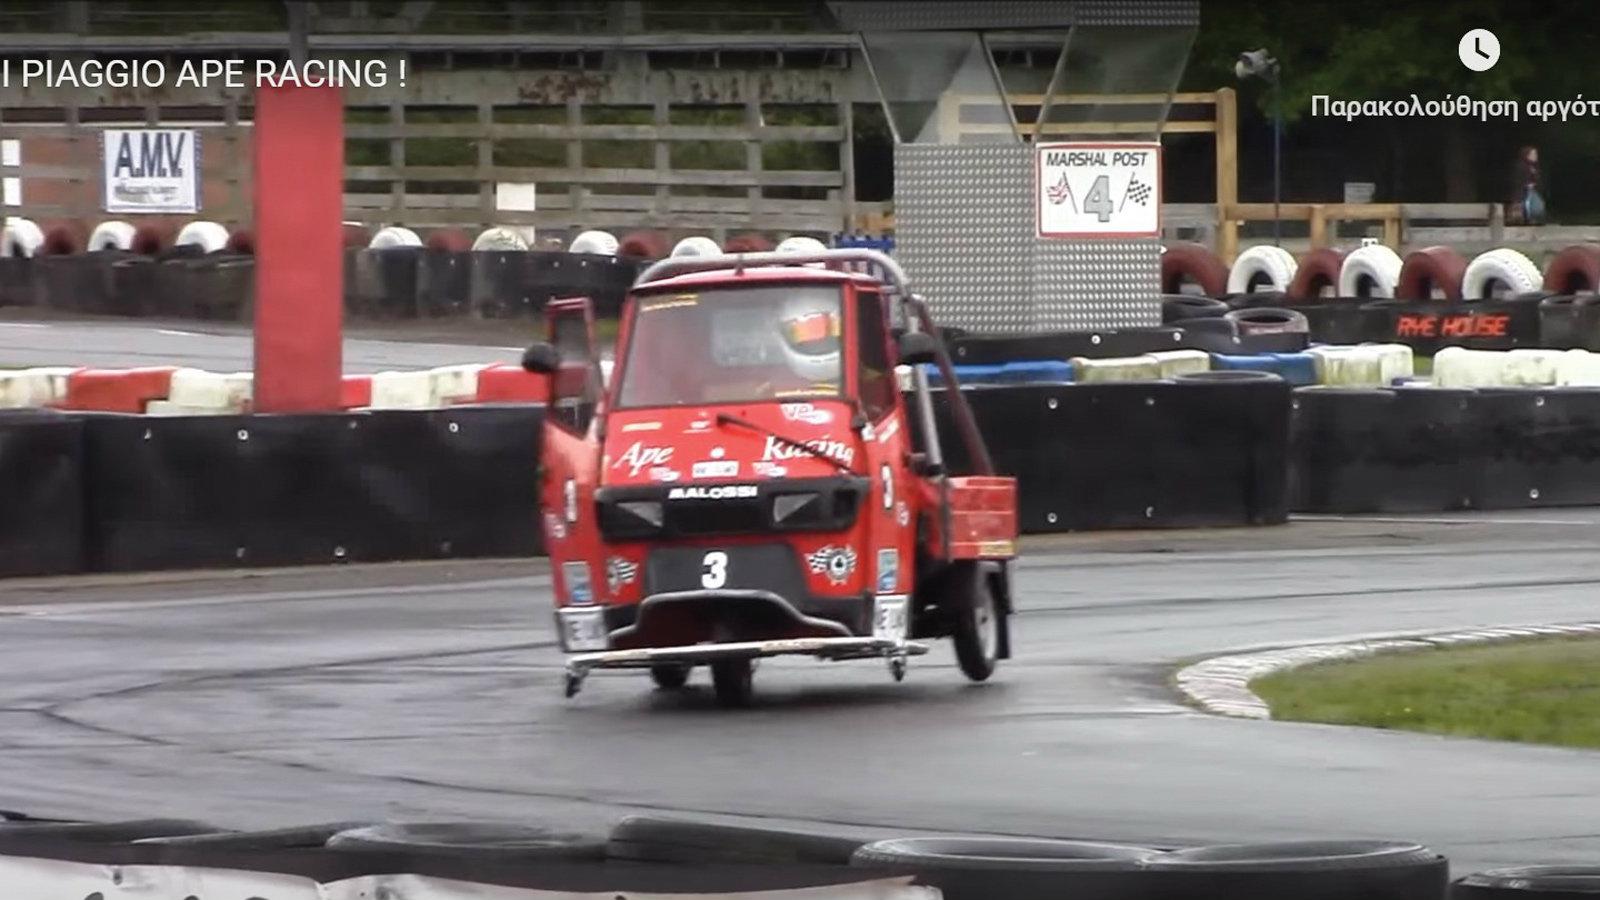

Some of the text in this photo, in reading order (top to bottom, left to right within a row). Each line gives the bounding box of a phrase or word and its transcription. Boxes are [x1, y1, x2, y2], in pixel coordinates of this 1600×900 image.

[113, 132, 186, 178] A.M.V.
[1046, 152, 1149, 167] MARSHAL POST
[1083, 174, 1113, 223] 4
[1397, 315, 1511, 337] RYE HOUSE
[611, 441, 676, 478] Ape
[667, 485, 759, 499] MALOSSI
[701, 551, 728, 589] 3
